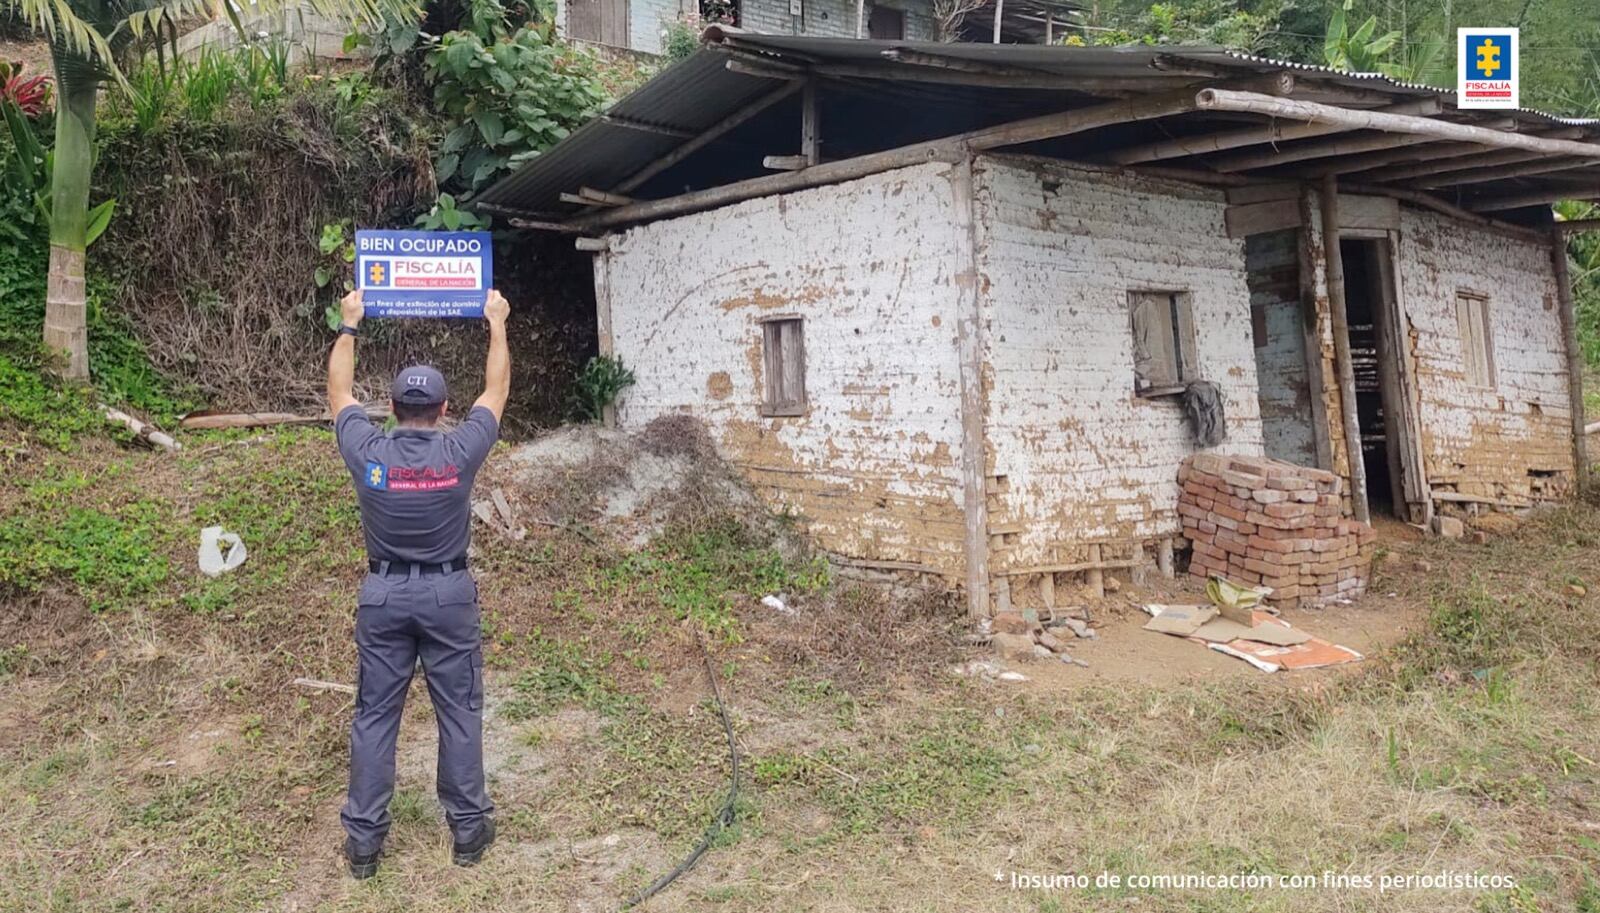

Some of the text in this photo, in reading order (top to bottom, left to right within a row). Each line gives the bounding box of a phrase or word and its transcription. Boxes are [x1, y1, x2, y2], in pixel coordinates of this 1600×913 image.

[360, 238, 482, 253] BIEN OCUPADO
[394, 260, 476, 275] FISCALÍA
[407, 375, 428, 386] CTI
